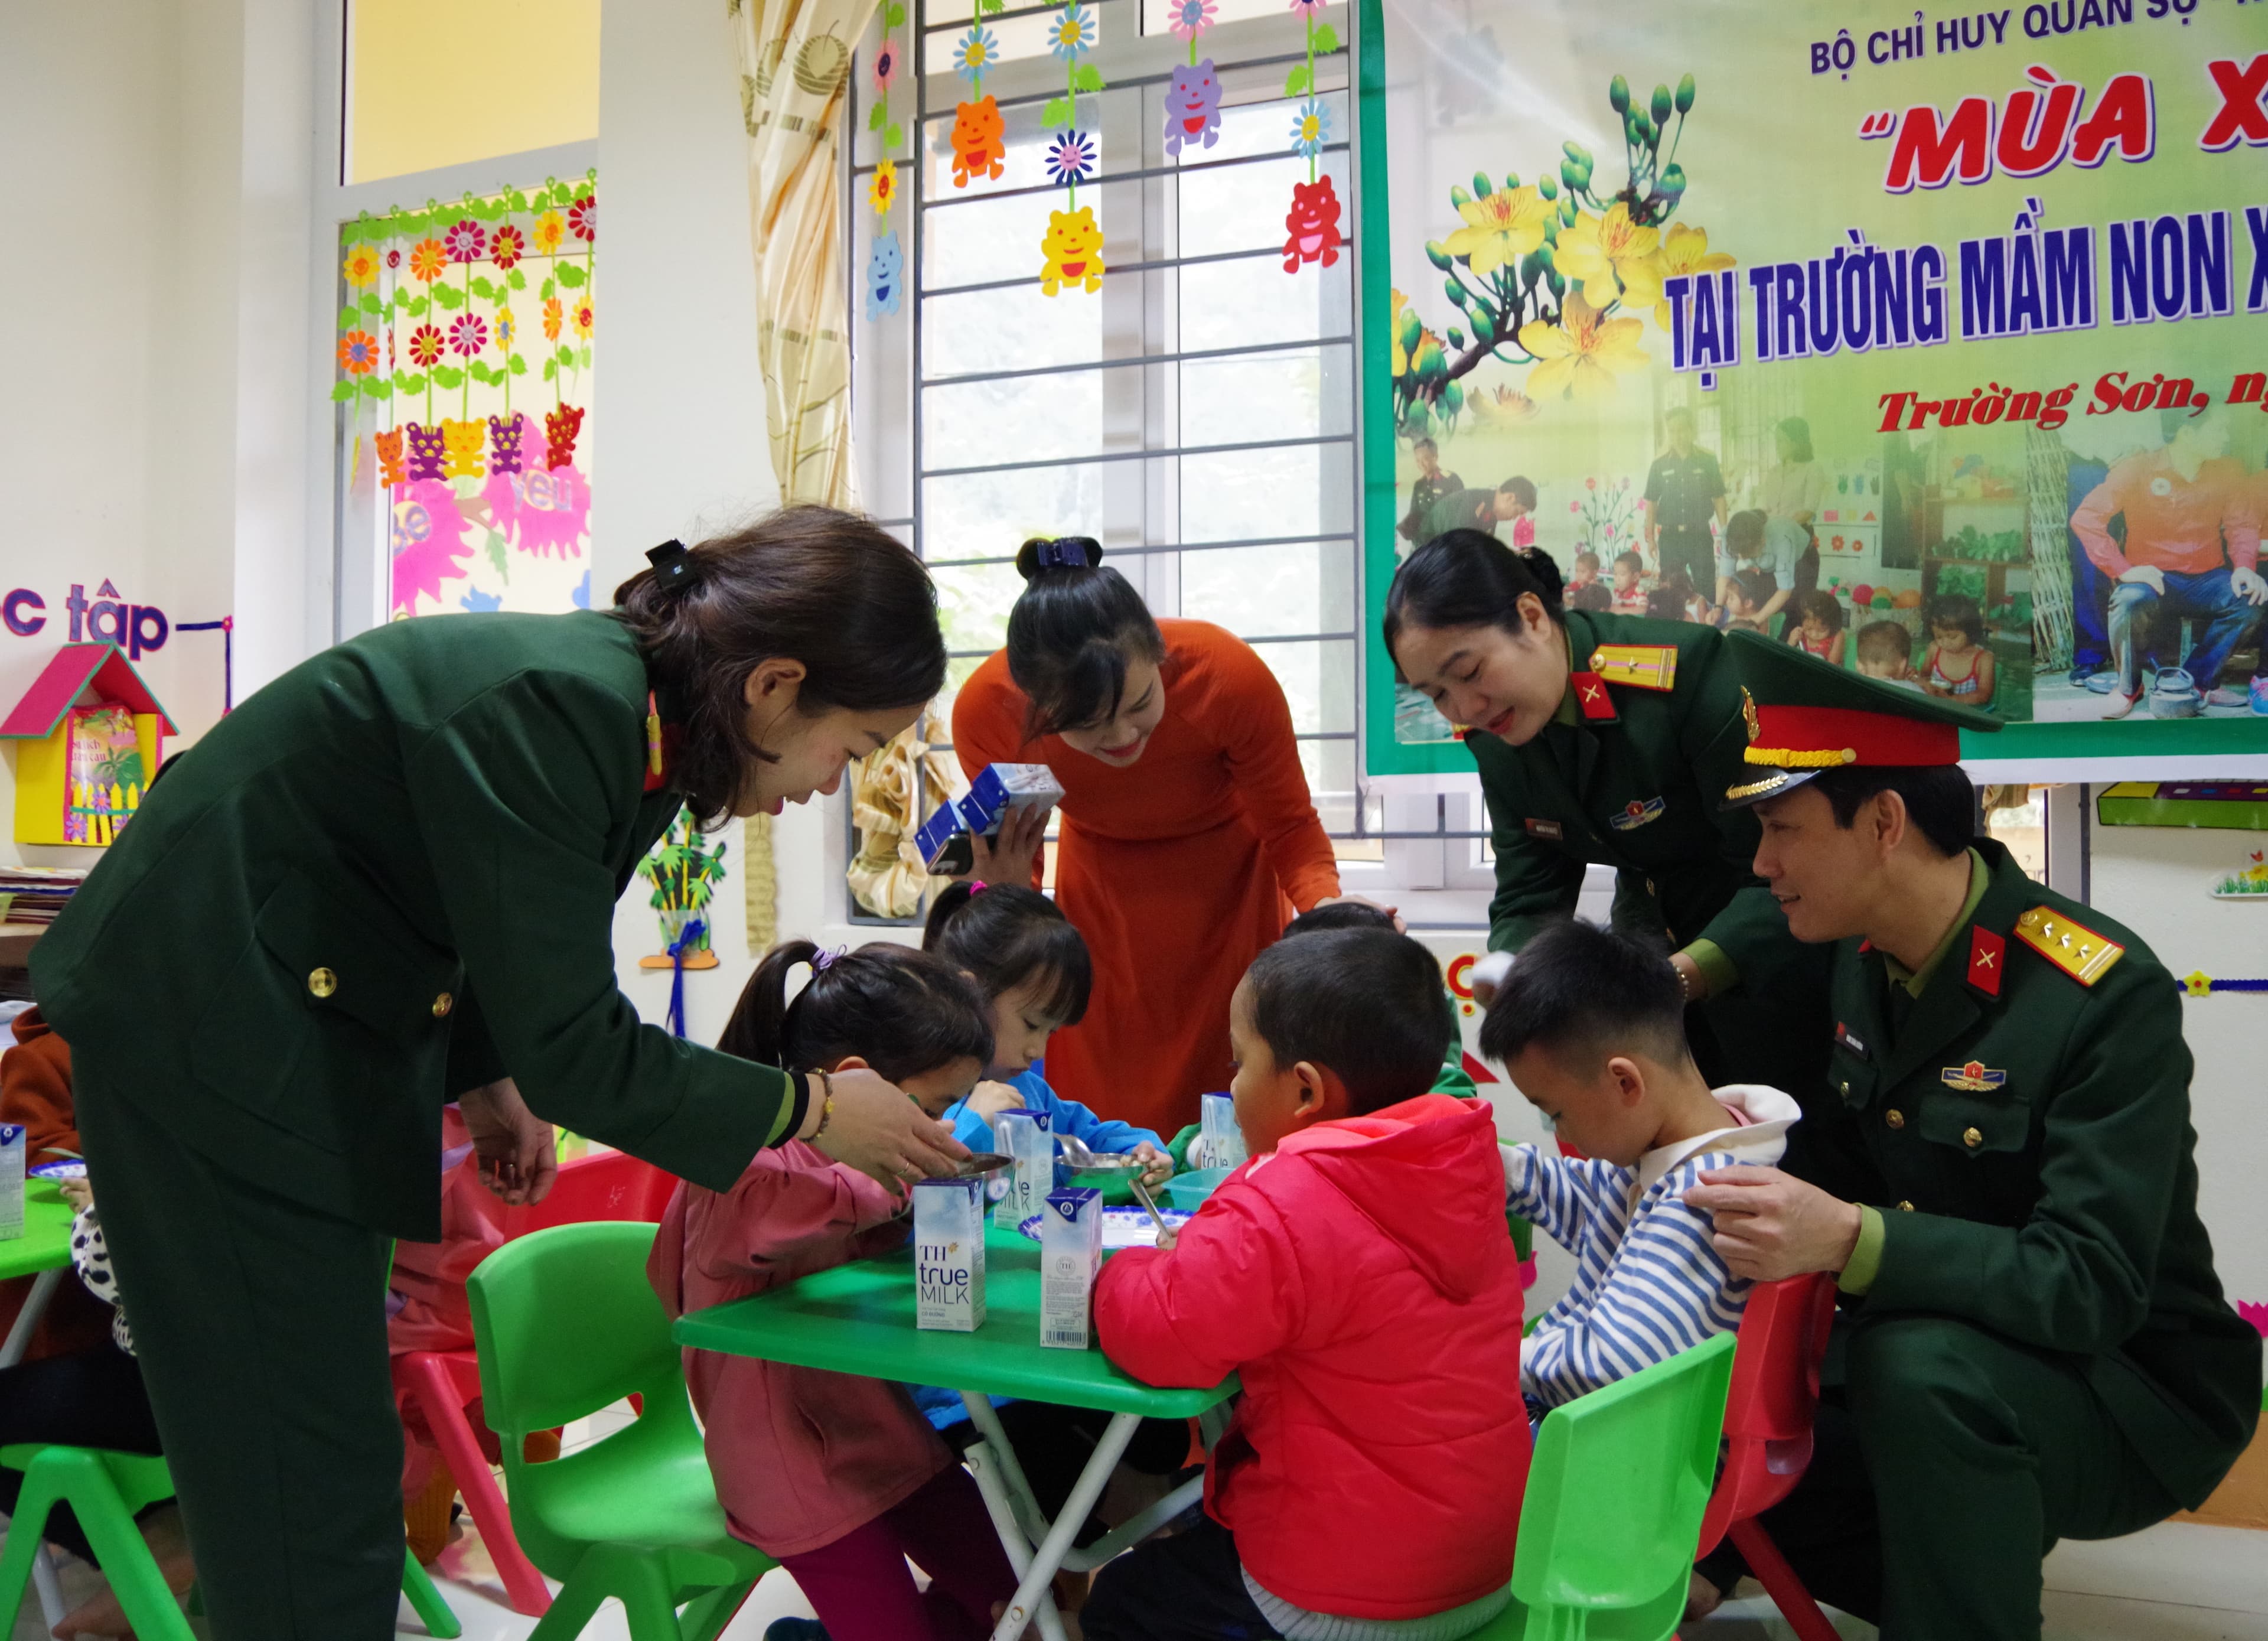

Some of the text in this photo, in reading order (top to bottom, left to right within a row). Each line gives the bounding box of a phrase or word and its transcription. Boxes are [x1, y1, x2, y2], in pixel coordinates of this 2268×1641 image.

[1810, 28, 1856, 80] BỘ
[1867, 10, 1924, 64] CHỈ
[1936, 9, 2012, 54] HUY
[1664, 269, 1739, 390] TẠI
[1749, 229, 1947, 362] TRƯỜNG
[1959, 197, 2097, 341] MẦM
[2110, 211, 2232, 325] NON
[1876, 371, 2268, 433] Trường Sơn, n
[919, 1262, 969, 1286] true
[920, 1245, 946, 1262] TH
[921, 1285, 969, 1305] MILK
